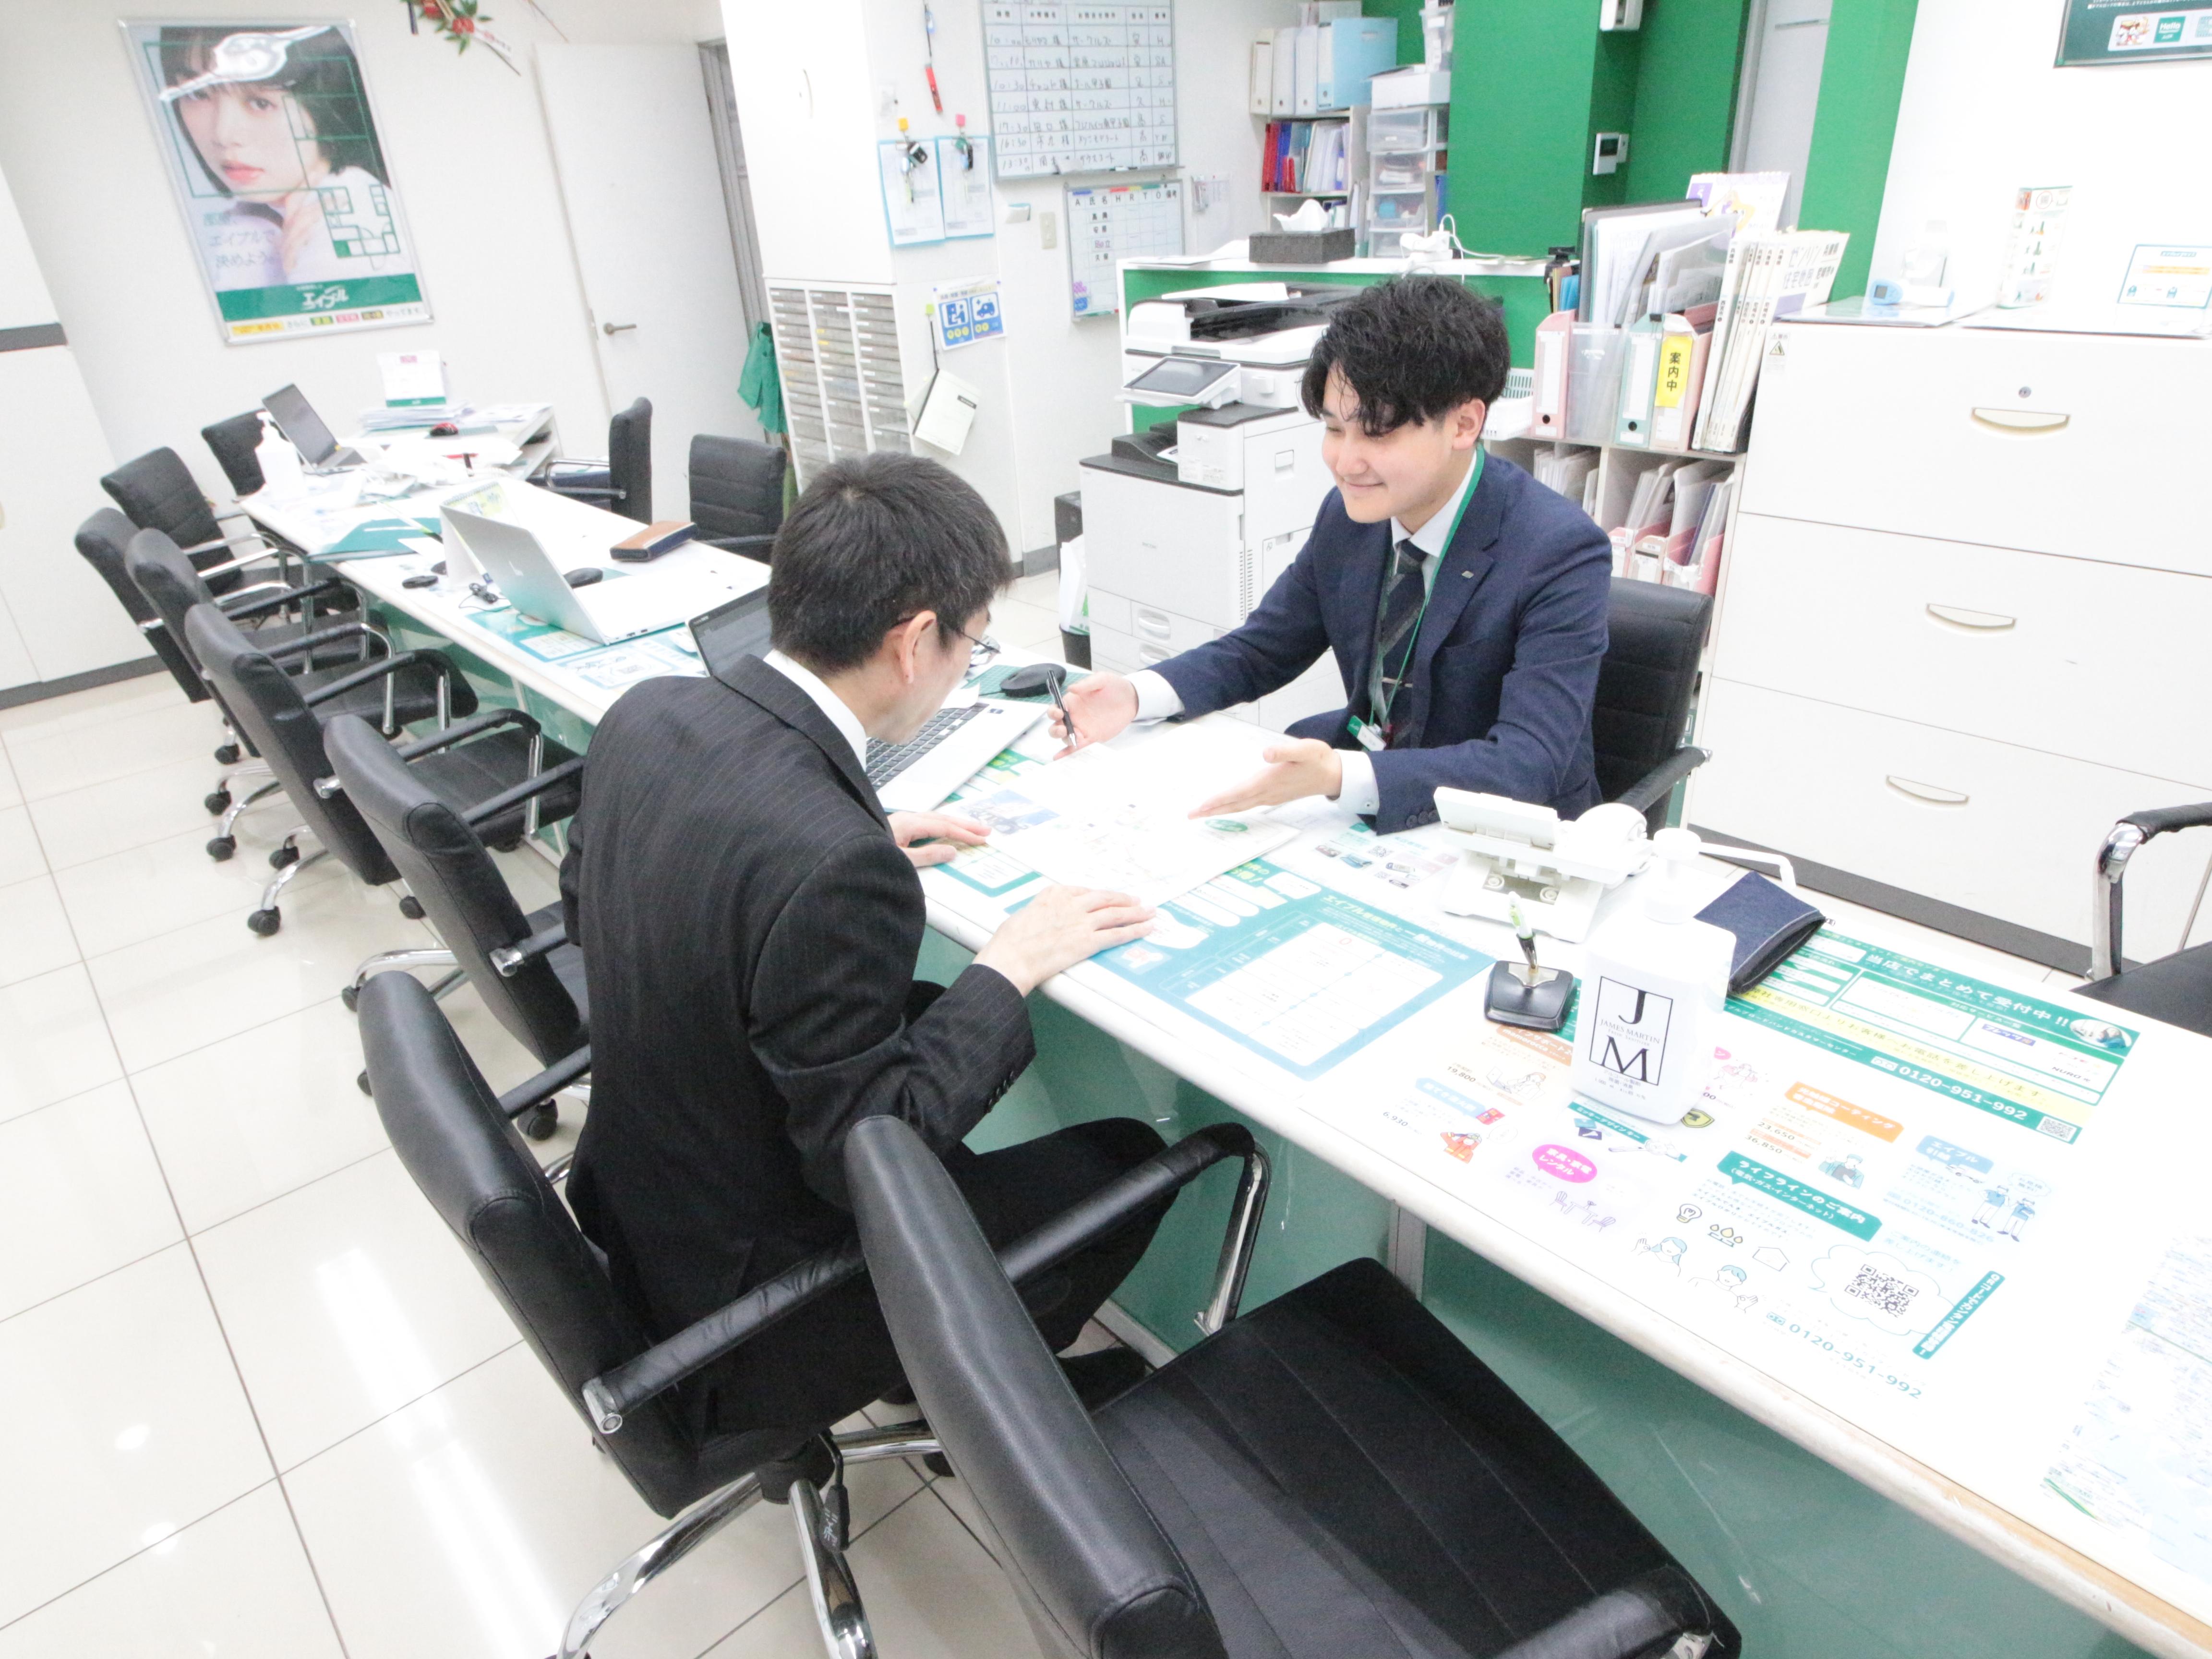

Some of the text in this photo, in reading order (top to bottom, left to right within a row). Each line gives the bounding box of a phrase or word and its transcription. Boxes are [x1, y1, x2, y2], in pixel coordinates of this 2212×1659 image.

[2160, 22, 2181, 30] Hello
[1075, 198, 1081, 206] A
[1130, 193, 1135, 201] R
[1143, 192, 1148, 200] T
[302, 286, 349, 310] エイブル
[1666, 351, 1682, 393] 案内中
[1618, 989, 1648, 1025] J
[1600, 1018, 1660, 1045] JAMES MARTIN
[1600, 1034, 1649, 1083] M
[1446, 1065, 1476, 1083] 19,800
[2052, 1066, 2082, 1080] NURO
[1899, 1066, 2027, 1120] 0120-951-992
[1382, 1111, 1408, 1127] 6,930
[1757, 1121, 1795, 1141] 23,650
[1744, 1134, 1783, 1154] 36,850
[1931, 1141, 1978, 1164] エイブル
[1539, 1155, 1575, 1176] レンタル
[1739, 1160, 1866, 1224] ライフラインのご案内
[1903, 1198, 1995, 1243] 0120-860-826
[1789, 1323, 1923, 1400] 0120-951-992
